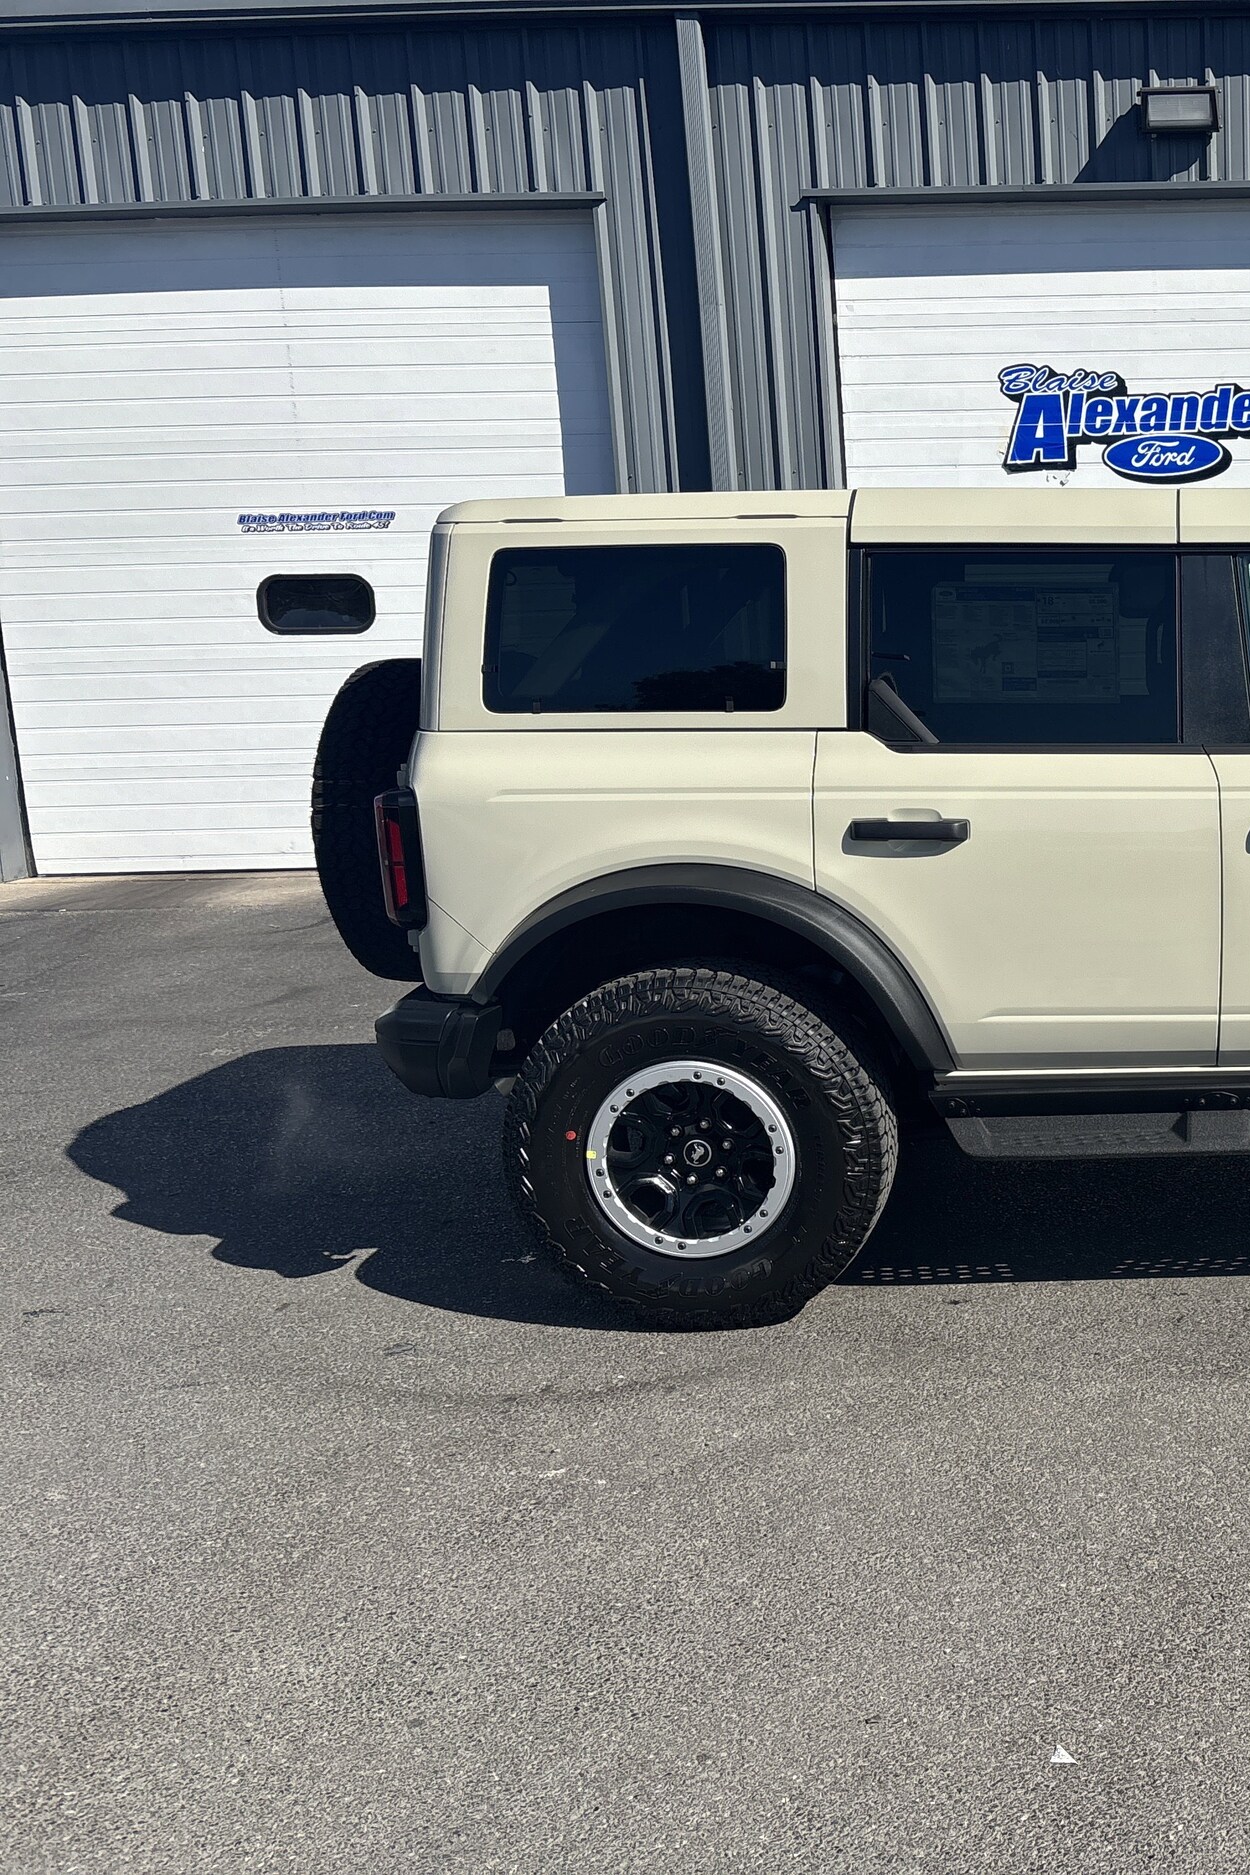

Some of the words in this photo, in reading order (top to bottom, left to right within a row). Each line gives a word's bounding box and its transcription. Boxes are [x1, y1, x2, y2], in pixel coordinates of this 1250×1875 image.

[1000, 364, 1119, 394] Blaise
[1131, 440, 1196, 468] Ford
[238, 514, 276, 524] Blaise
[277, 512, 338, 524] Alexander
